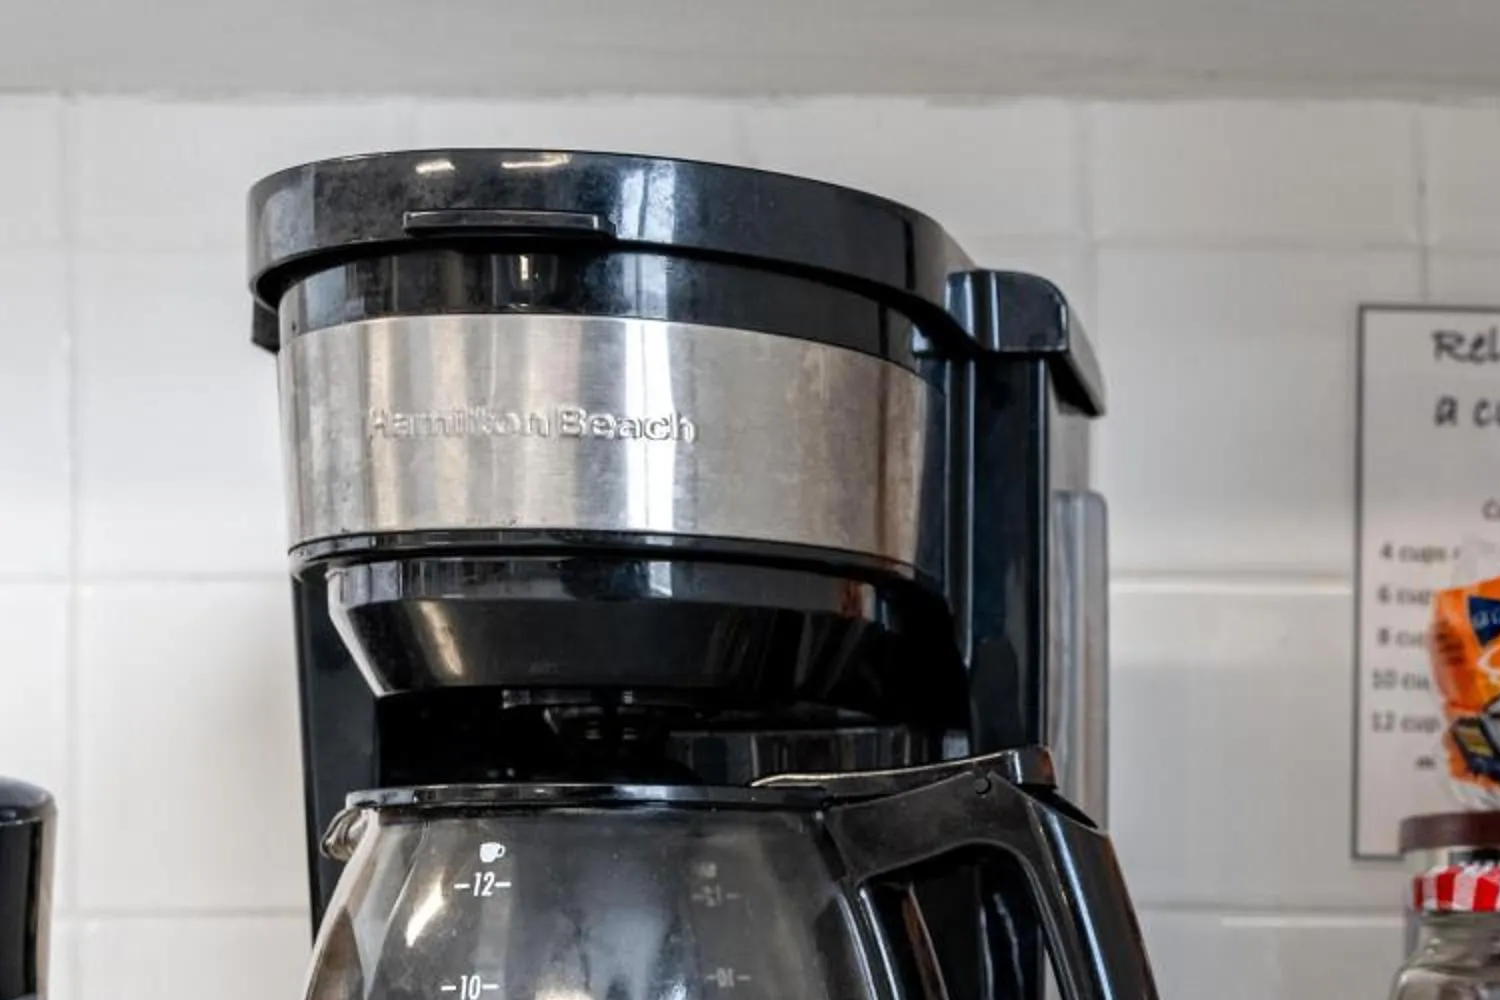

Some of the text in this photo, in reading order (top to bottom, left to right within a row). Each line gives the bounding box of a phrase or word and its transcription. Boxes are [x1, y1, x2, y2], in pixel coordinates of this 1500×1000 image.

[556, 404, 697, 443] Beach
[1435, 396, 1458, 427] a
[1372, 709, 1396, 732] 12
